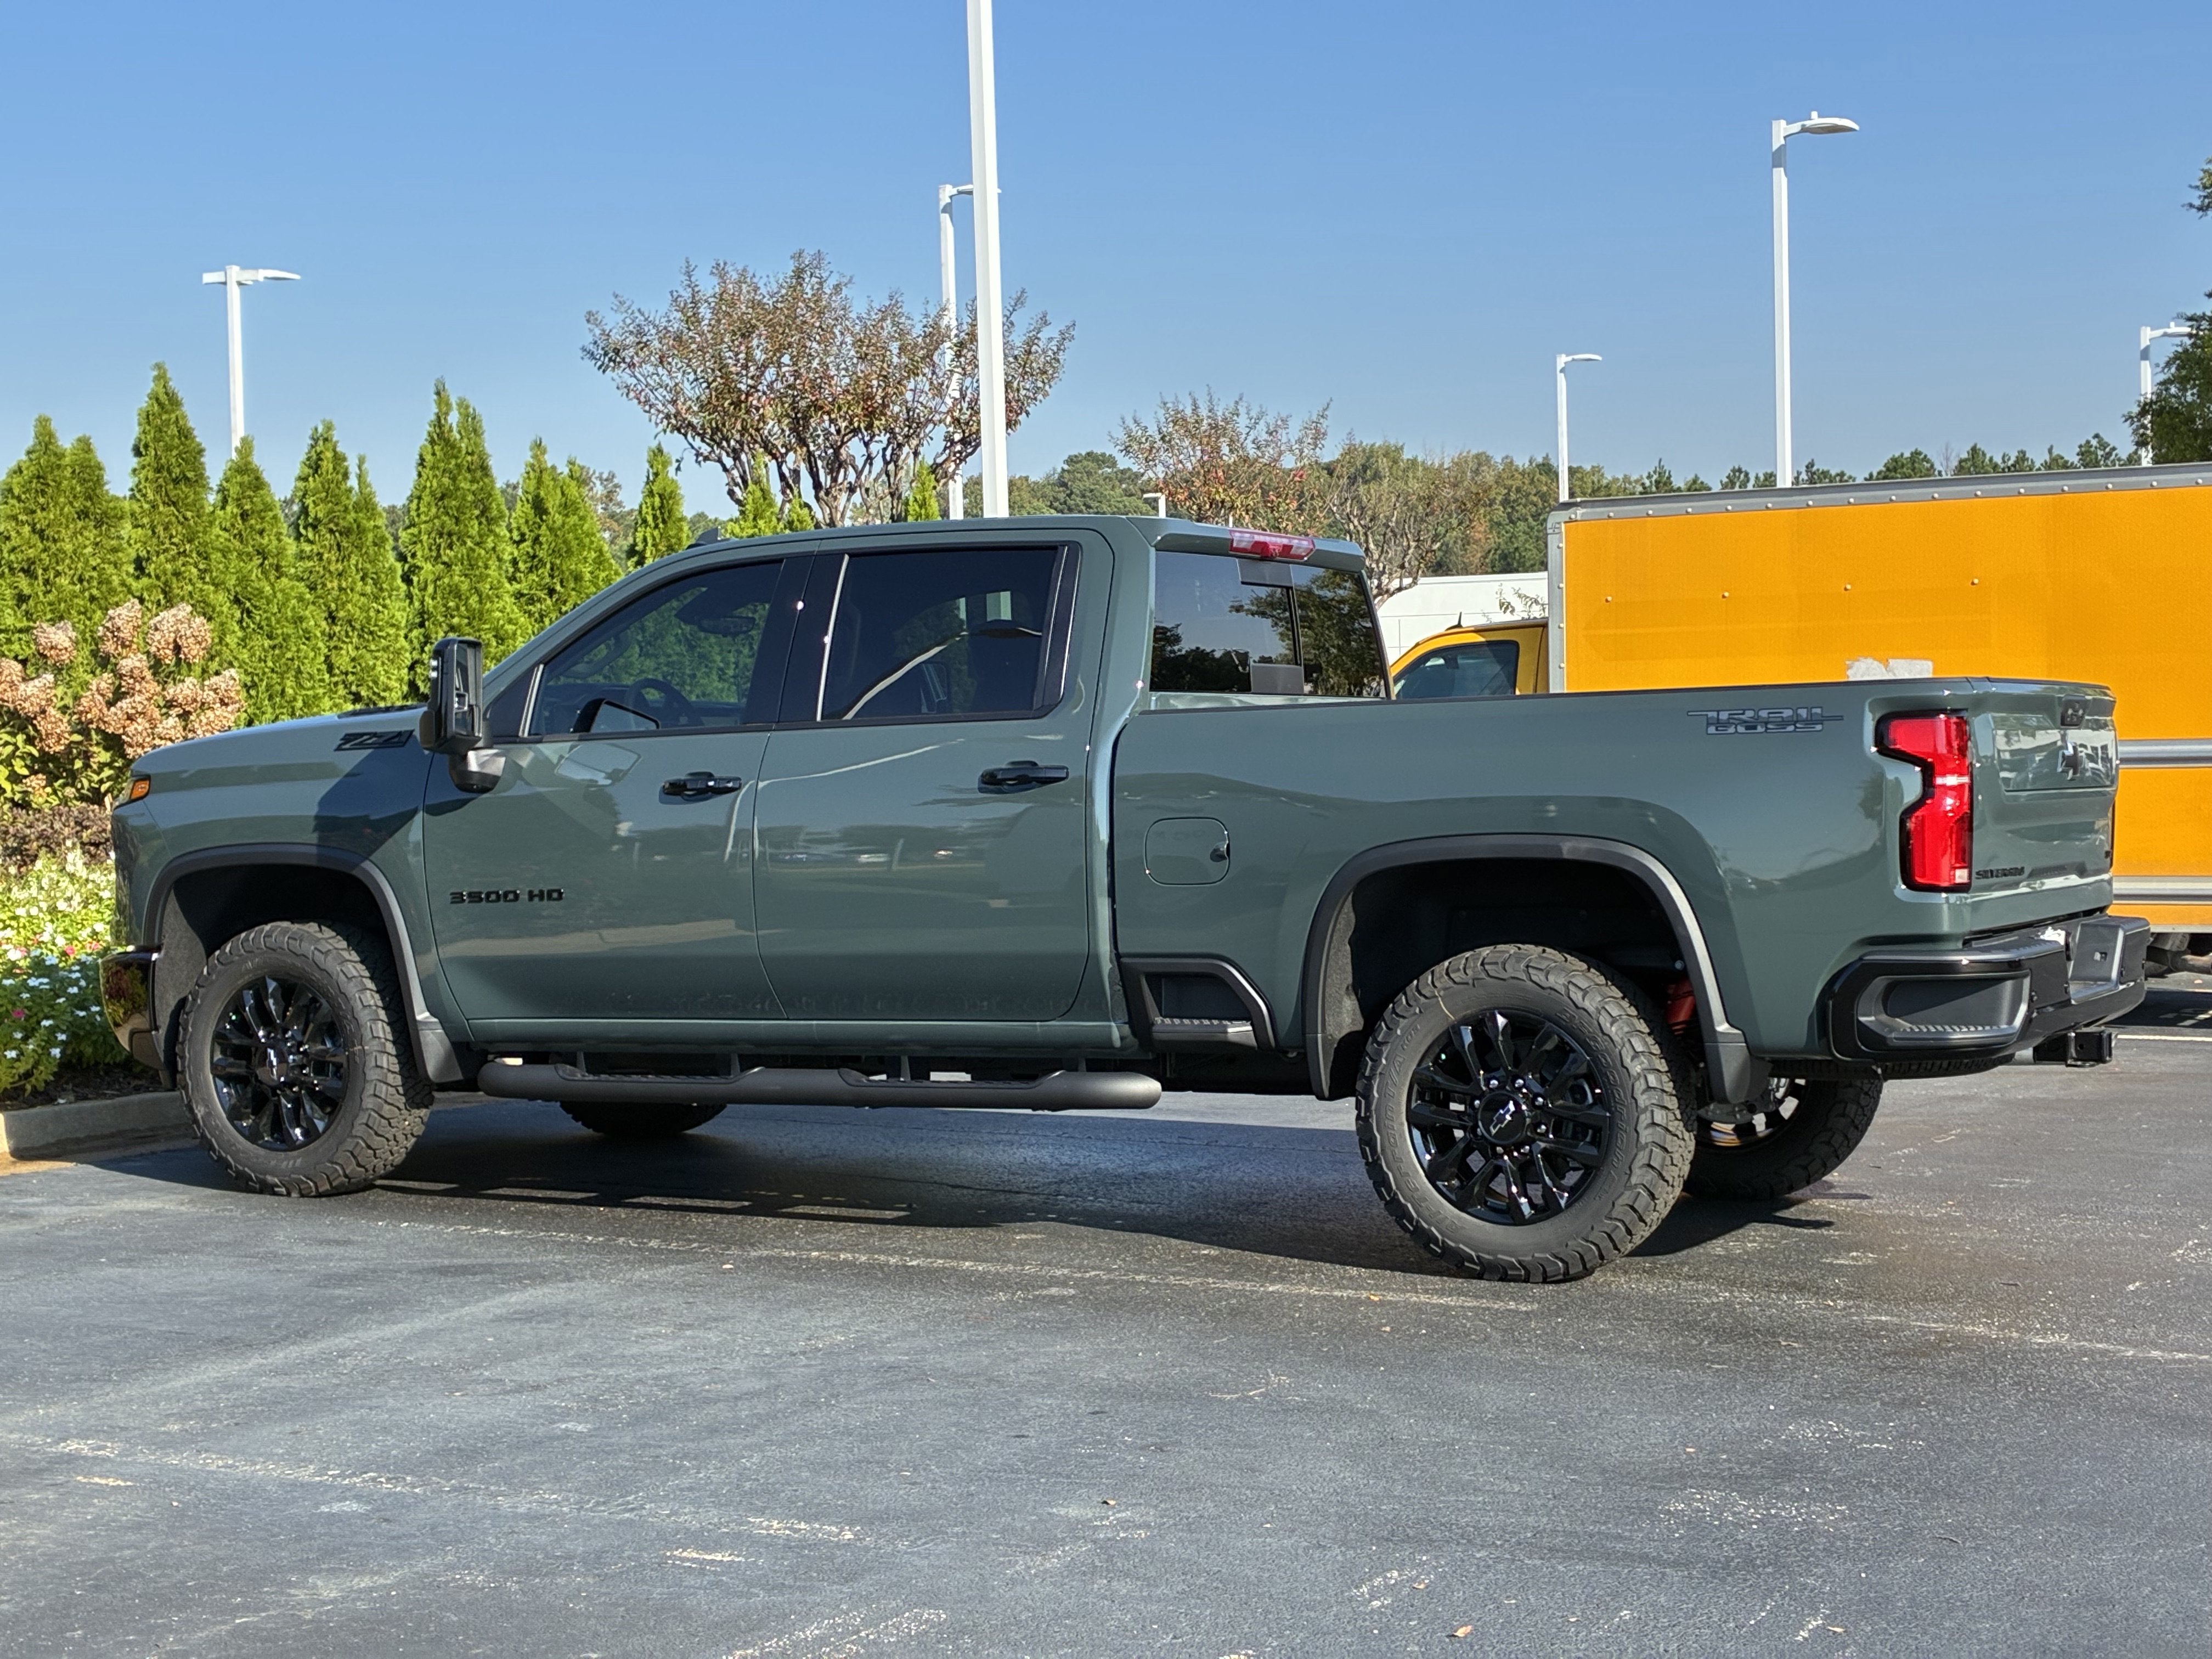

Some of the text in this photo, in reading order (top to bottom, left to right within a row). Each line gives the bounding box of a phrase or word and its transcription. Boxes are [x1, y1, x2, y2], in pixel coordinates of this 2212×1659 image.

[1686, 707, 1844, 724] TRAIL
[1706, 721, 1824, 735] BOSS
[334, 729, 415, 752] Z71
[449, 888, 565, 905] 3500 HD
